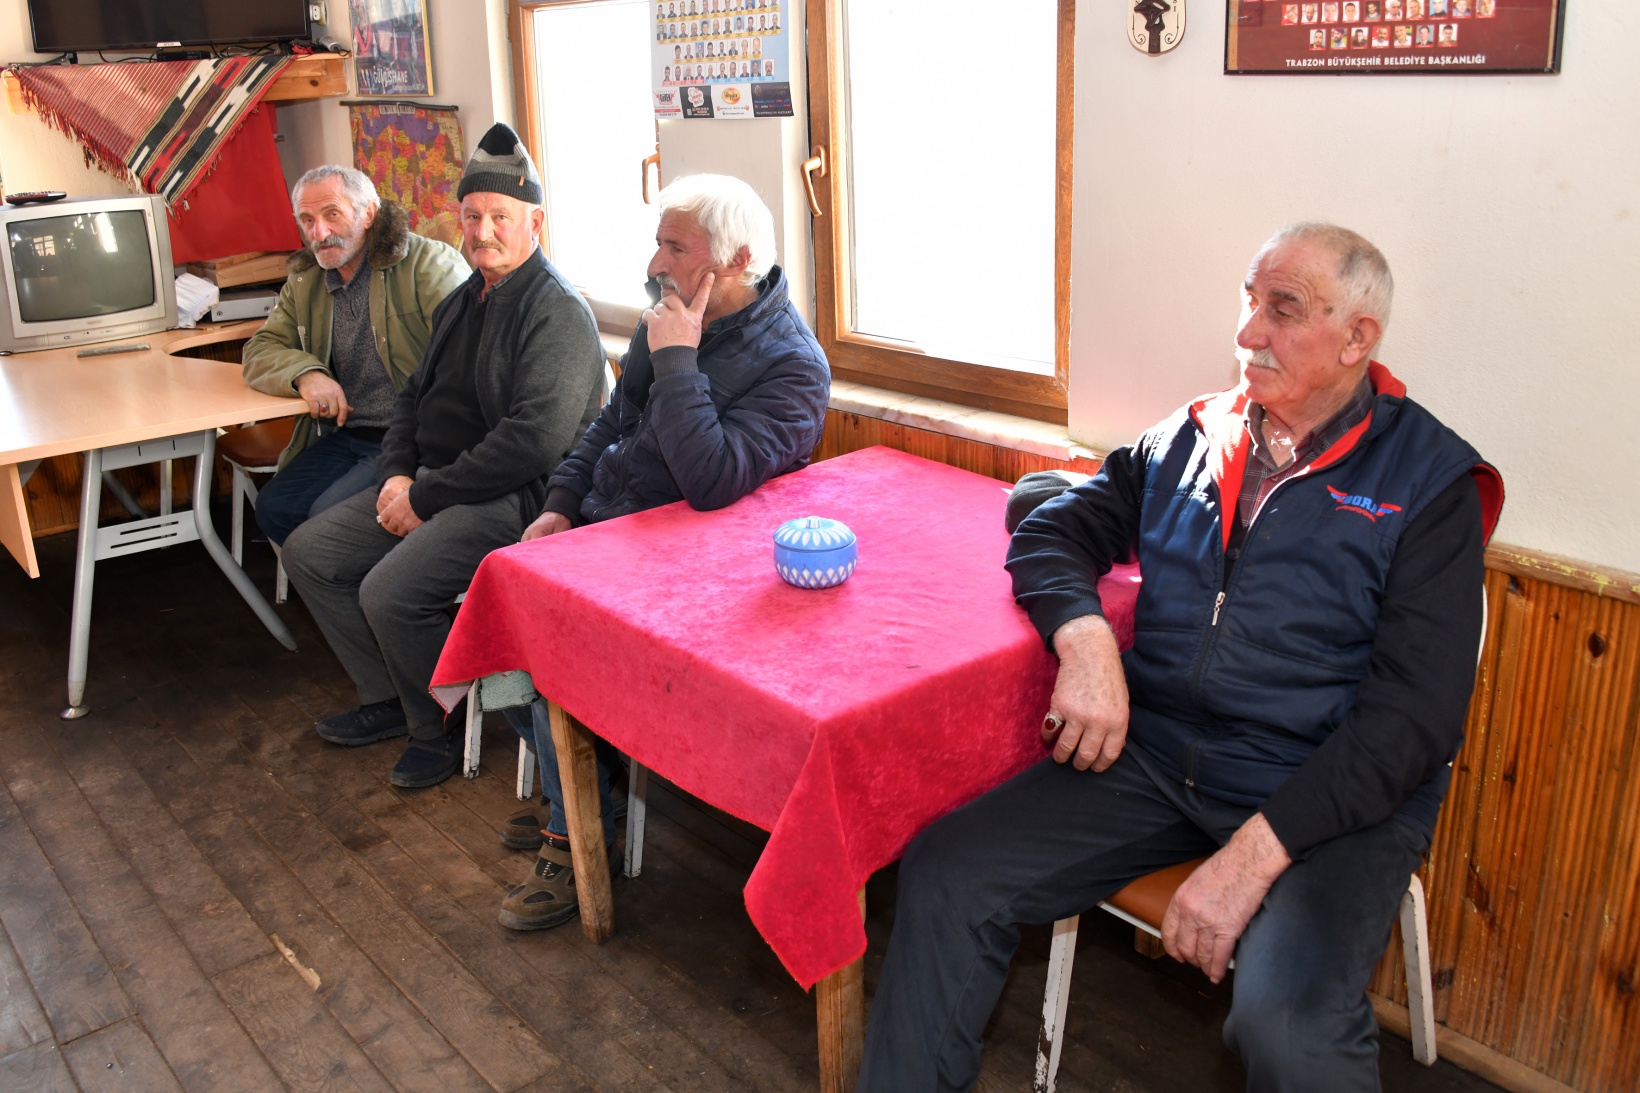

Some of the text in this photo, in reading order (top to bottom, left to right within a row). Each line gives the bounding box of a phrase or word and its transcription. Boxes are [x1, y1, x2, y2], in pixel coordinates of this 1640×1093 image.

[1286, 53, 1486, 67] TRABZON BÜYÜKŞEHİR BELEDİYE BAŞKANLIĞI
